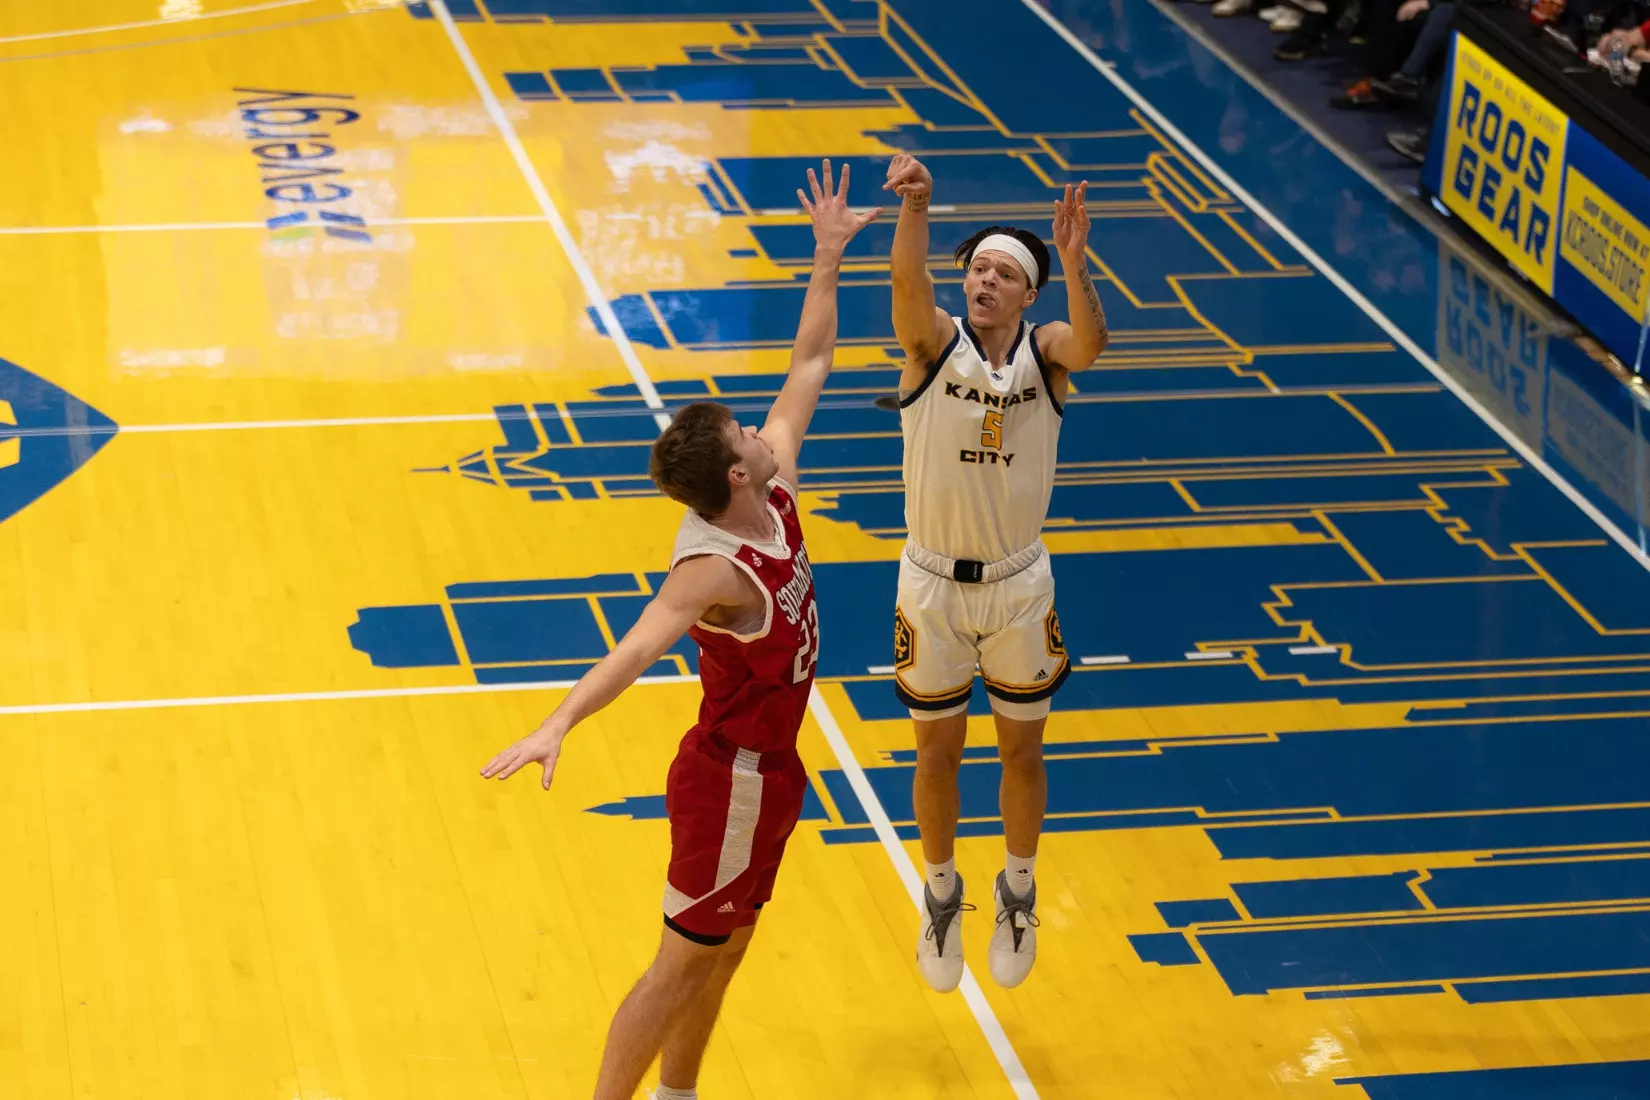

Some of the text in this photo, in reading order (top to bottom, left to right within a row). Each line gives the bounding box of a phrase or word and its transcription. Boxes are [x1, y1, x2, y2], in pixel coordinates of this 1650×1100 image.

[232, 86, 361, 203] evergy
[1457, 80, 1550, 195] ROOS
[1454, 143, 1550, 266] GEAR
[945, 381, 1037, 409] KANSAS
[980, 410, 1004, 450] 5
[960, 450, 1015, 467] CITY
[792, 598, 820, 685] 23
